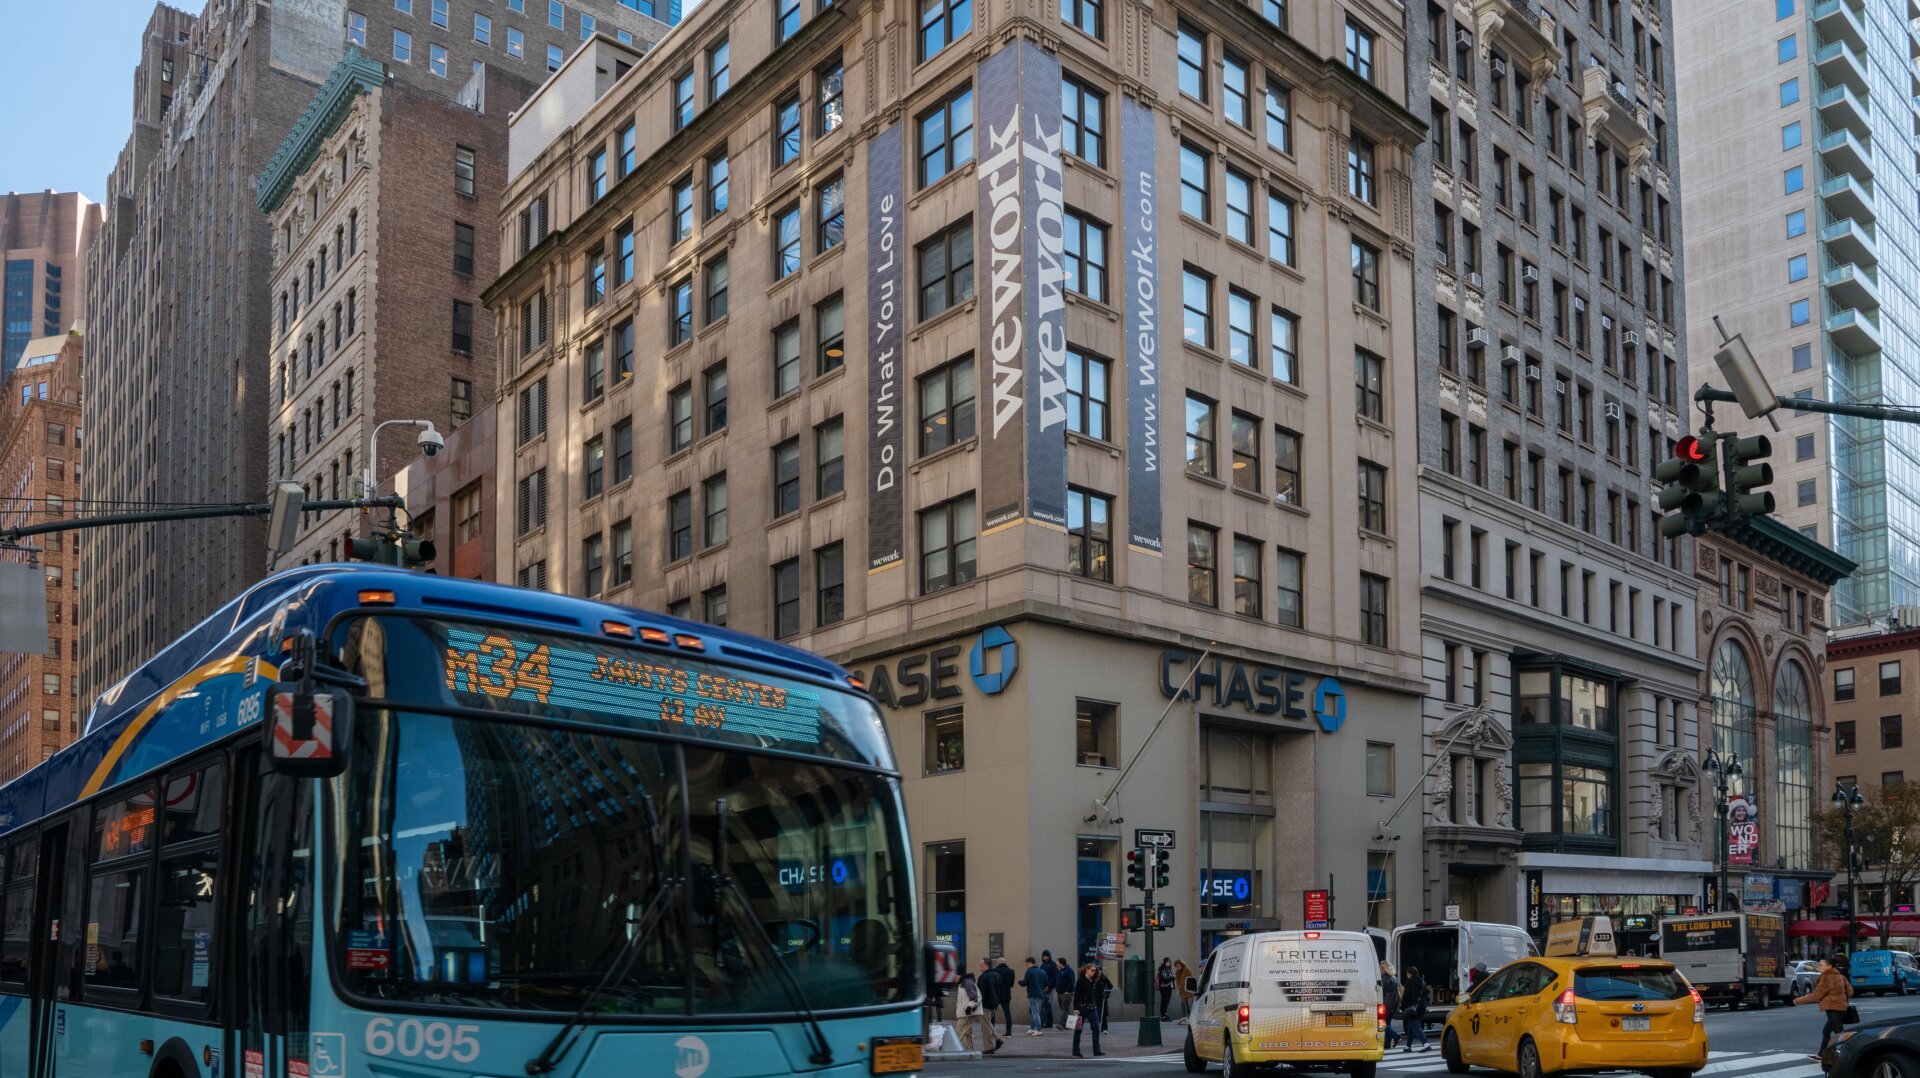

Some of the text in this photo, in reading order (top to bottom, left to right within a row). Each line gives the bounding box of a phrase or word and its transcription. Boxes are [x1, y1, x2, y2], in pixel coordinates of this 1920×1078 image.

[978, 103, 1023, 440] wework
[1023, 113, 1067, 433] wework
[877, 193, 894, 492] Do What You Love
[986, 511, 1019, 527] wework.com
[872, 549, 899, 566] wework
[1133, 534, 1162, 548] wework
[446, 636, 553, 704] M34
[854, 644, 963, 709] ASE
[1159, 650, 1308, 719] CHASE
[696, 672, 788, 709] CENTER
[237, 691, 261, 726] 6095
[659, 697, 726, 729] 12 AV
[1201, 879, 1233, 896] ASE
[1529, 907, 1539, 929] etc.
[1672, 923, 1687, 931] THE
[1689, 921, 1710, 930] LONG
[1276, 950, 1357, 960] TRITECH
[365, 1017, 480, 1063] 6095
